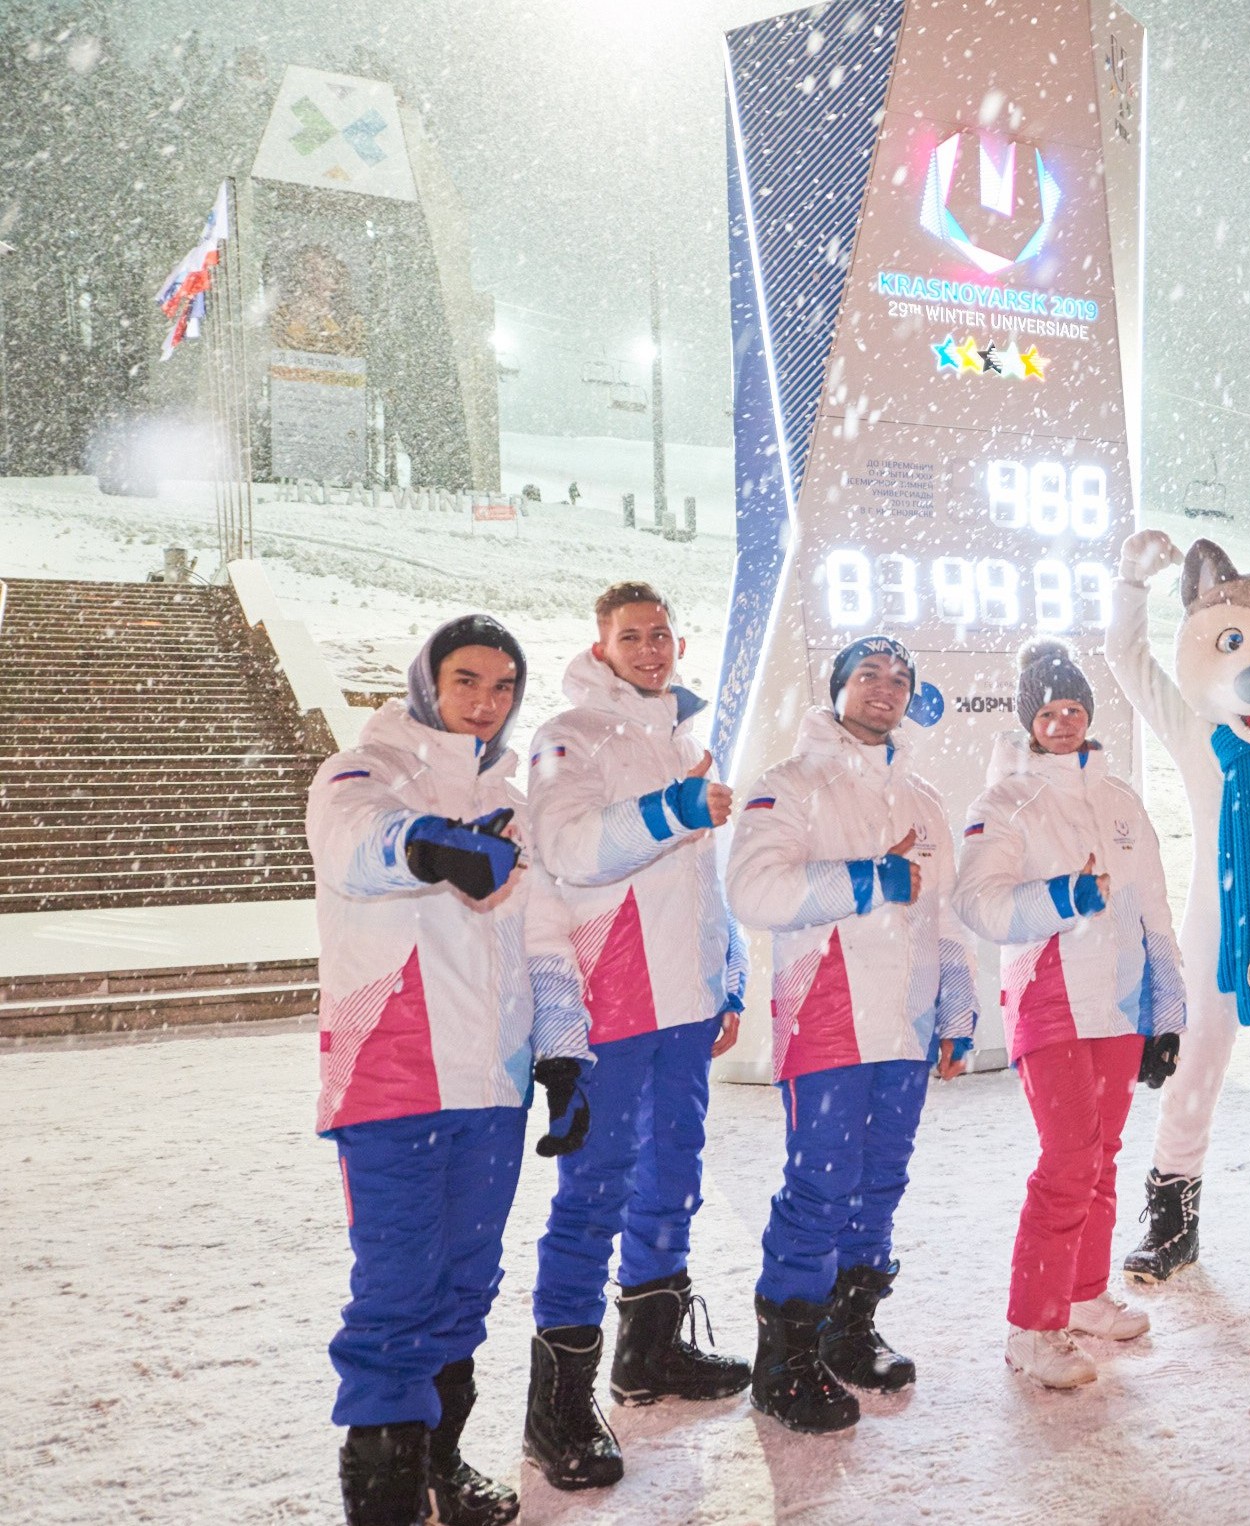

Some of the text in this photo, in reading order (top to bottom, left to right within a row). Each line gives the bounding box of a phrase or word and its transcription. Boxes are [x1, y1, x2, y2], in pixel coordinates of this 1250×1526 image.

[878, 271, 1100, 321] KRASNOYARSK 2019
[888, 301, 1090, 340] 29TH WINTER UNIVERSIADE
